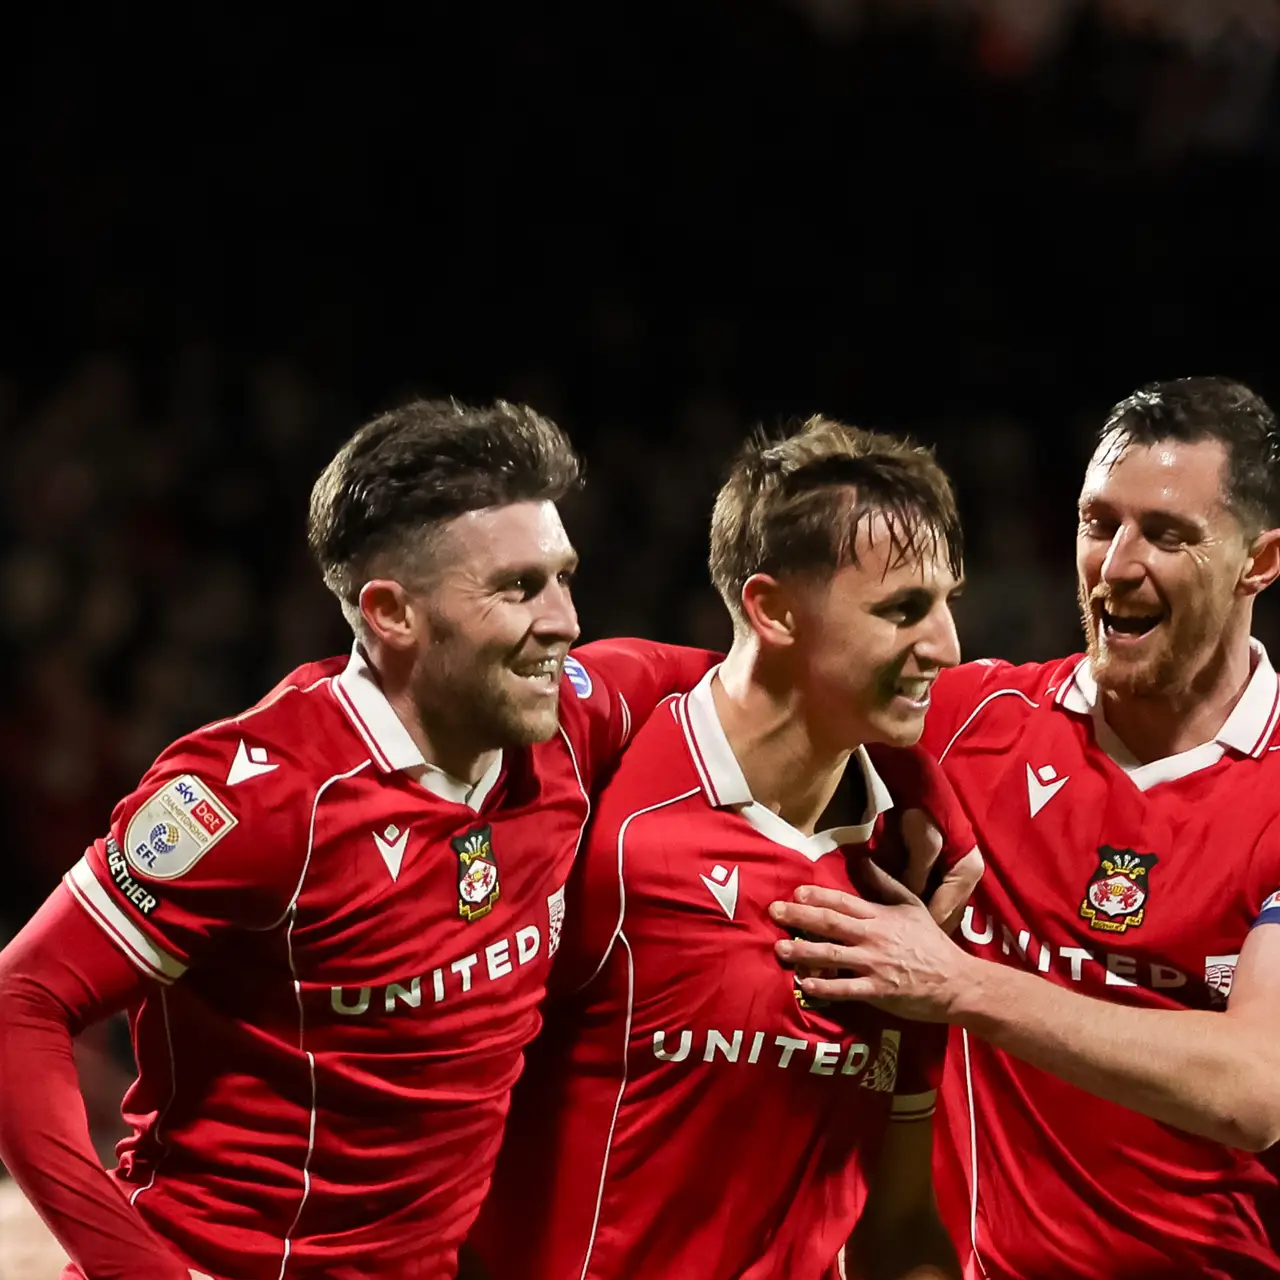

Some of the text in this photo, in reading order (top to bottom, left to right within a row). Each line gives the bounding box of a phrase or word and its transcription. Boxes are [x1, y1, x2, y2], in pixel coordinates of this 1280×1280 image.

[162, 794, 208, 843] CHAMPIONSHIP
[175, 782, 220, 831] sky bet
[107, 838, 157, 914] GETHER
[136, 843, 157, 868] EFL
[330, 925, 541, 1015] UNITED
[960, 906, 1188, 987] UNITED
[653, 1029, 870, 1076] UNITED
